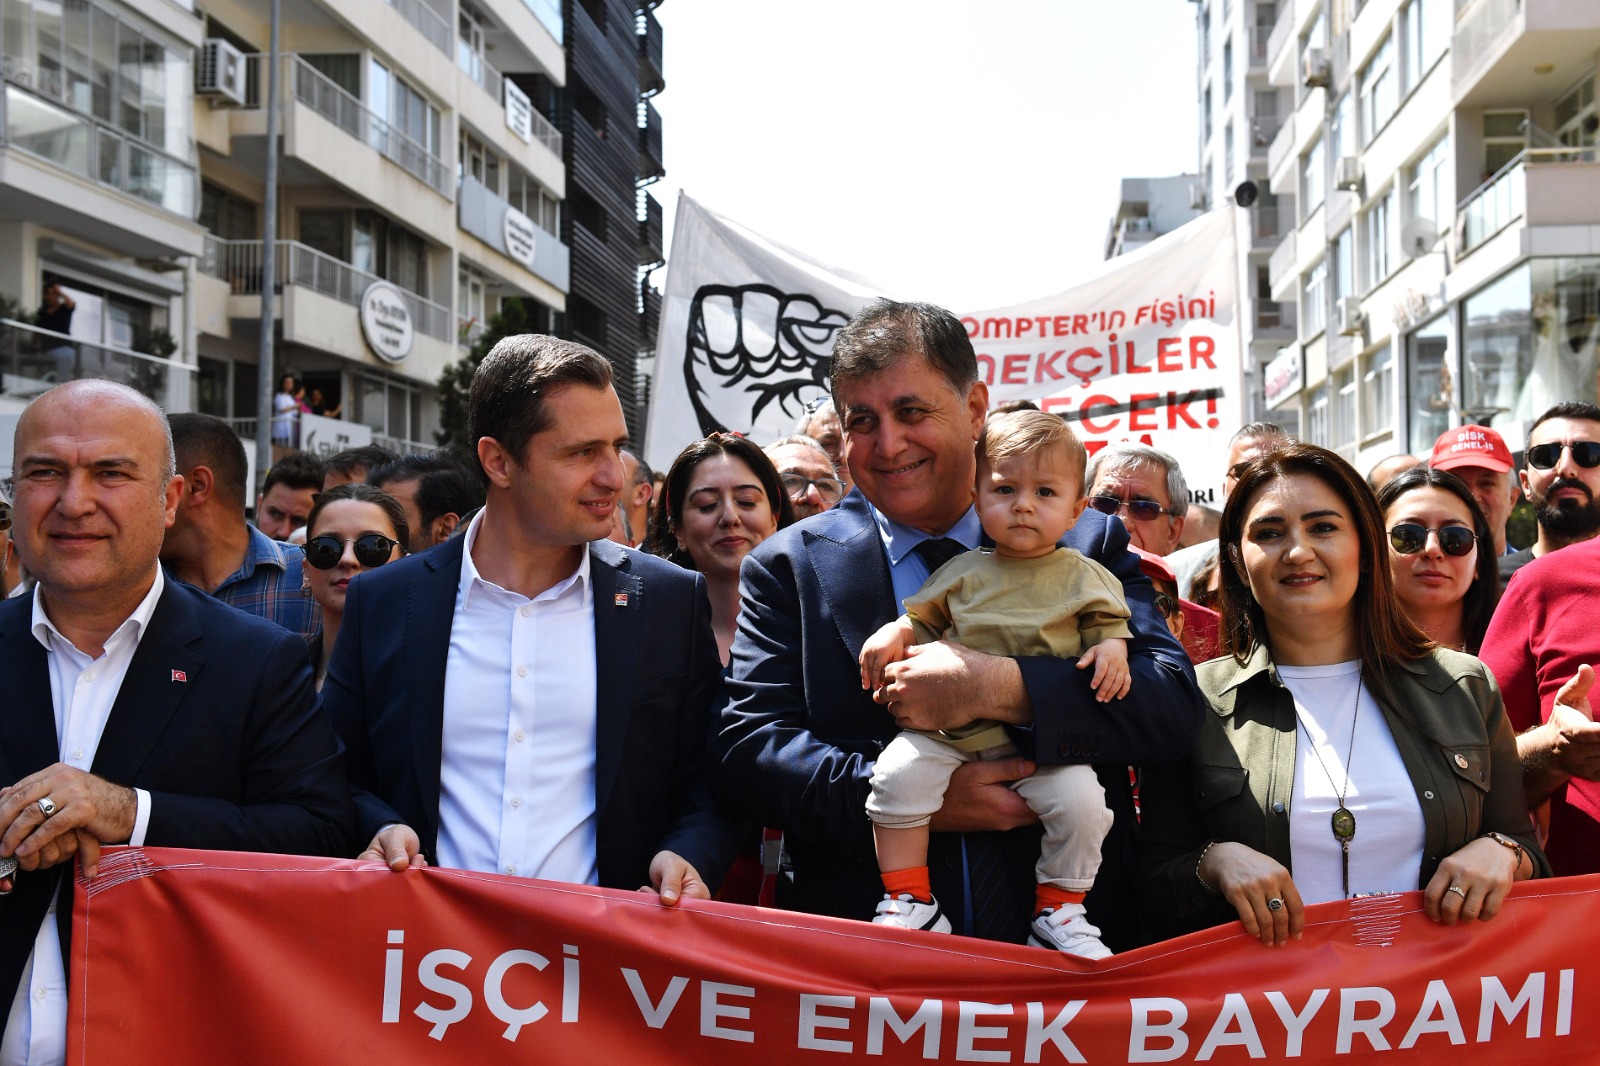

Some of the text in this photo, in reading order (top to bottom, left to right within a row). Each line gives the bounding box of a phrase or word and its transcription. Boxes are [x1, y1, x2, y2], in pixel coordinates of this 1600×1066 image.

[1457, 430, 1486, 441] DİSK
[382, 929, 1575, 1064] İŞÇİ VE EMEK BAYRAMI
